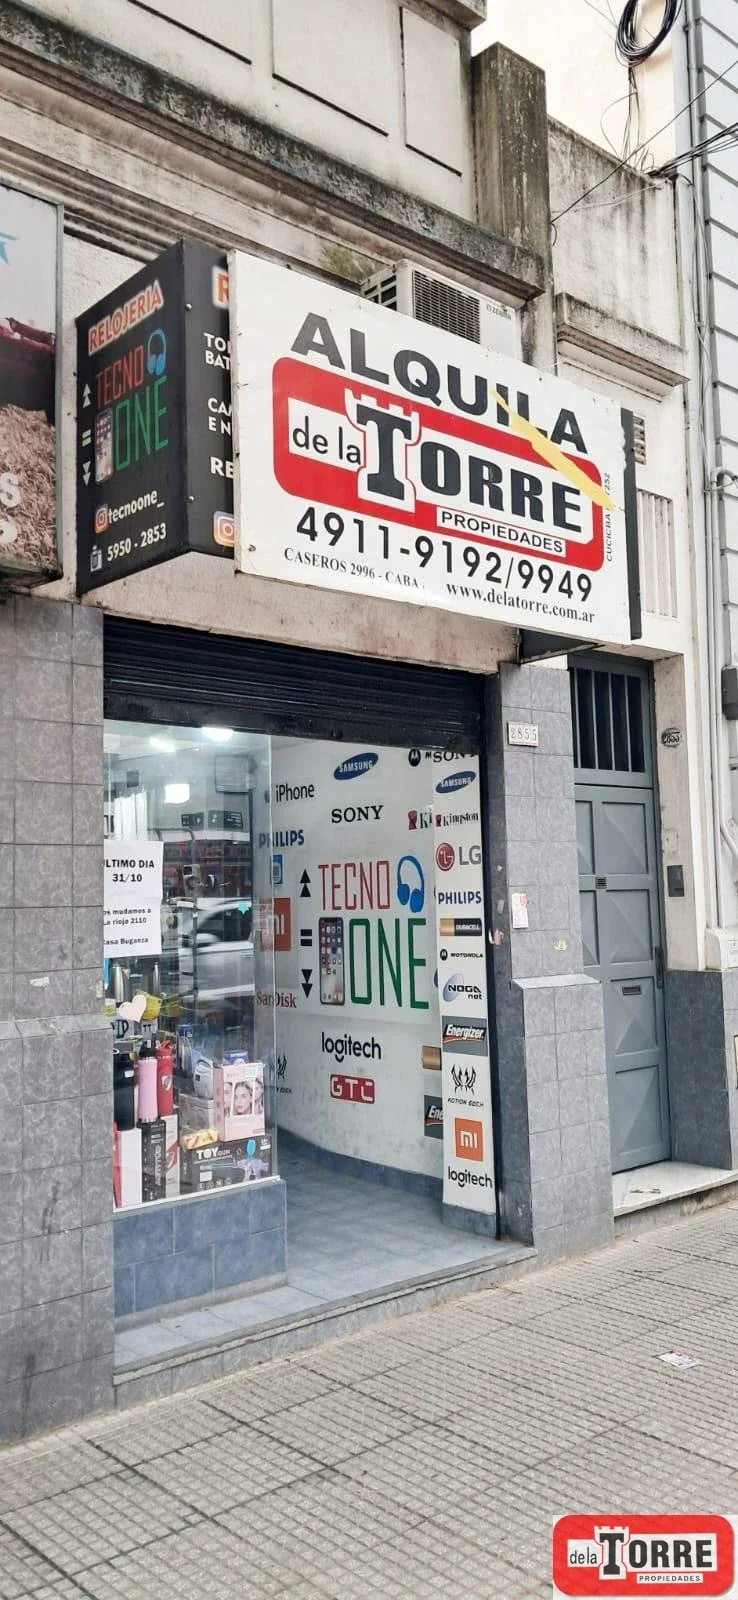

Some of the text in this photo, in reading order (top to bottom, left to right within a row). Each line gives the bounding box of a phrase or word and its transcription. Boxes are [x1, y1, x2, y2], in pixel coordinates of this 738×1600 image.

[88, 280, 164, 355] RELOJERIA
[203, 332, 230, 354] TO
[95, 345, 145, 408] TECNO
[290, 312, 588, 454] ALQUILA
[115, 376, 169, 472] ONE
[292, 403, 582, 533] de la TORRE
[108, 488, 165, 524] tecnoone_
[107, 538, 131, 562] 5950
[140, 522, 168, 548] 2853
[441, 511, 564, 554] PROPIEDADES
[284, 546, 347, 574] CASEROS
[350, 562, 376, 580] 2996
[296, 506, 593, 602] 4911-9192/9949
[446, 582, 596, 624] www.delatorre.com.ar
[510, 726, 538, 742] 2855
[339, 758, 374, 774] SAMSUNG
[433, 750, 474, 763] SON
[275, 783, 315, 803] iPhone
[440, 776, 472, 788] SAMSUNG
[331, 805, 384, 824] SONY
[259, 829, 305, 849] PHILIPS
[104, 859, 155, 868] LTIMO DIA
[458, 844, 482, 866] LG
[112, 873, 143, 883] 31/10
[318, 860, 391, 911] TECNO
[438, 890, 482, 905] PHILIPS
[112, 907, 146, 916] mudamos
[349, 917, 430, 1010] ONE
[447, 984, 482, 993] NOGA
[467, 992, 482, 1000] net
[257, 991, 297, 1009] SanDisk
[445, 1023, 485, 1041] Energizer
[321, 1031, 382, 1063] logitech
[331, 1076, 375, 1103] GTC
[196, 1146, 219, 1160] TOY
[448, 1166, 493, 1189] logitech
